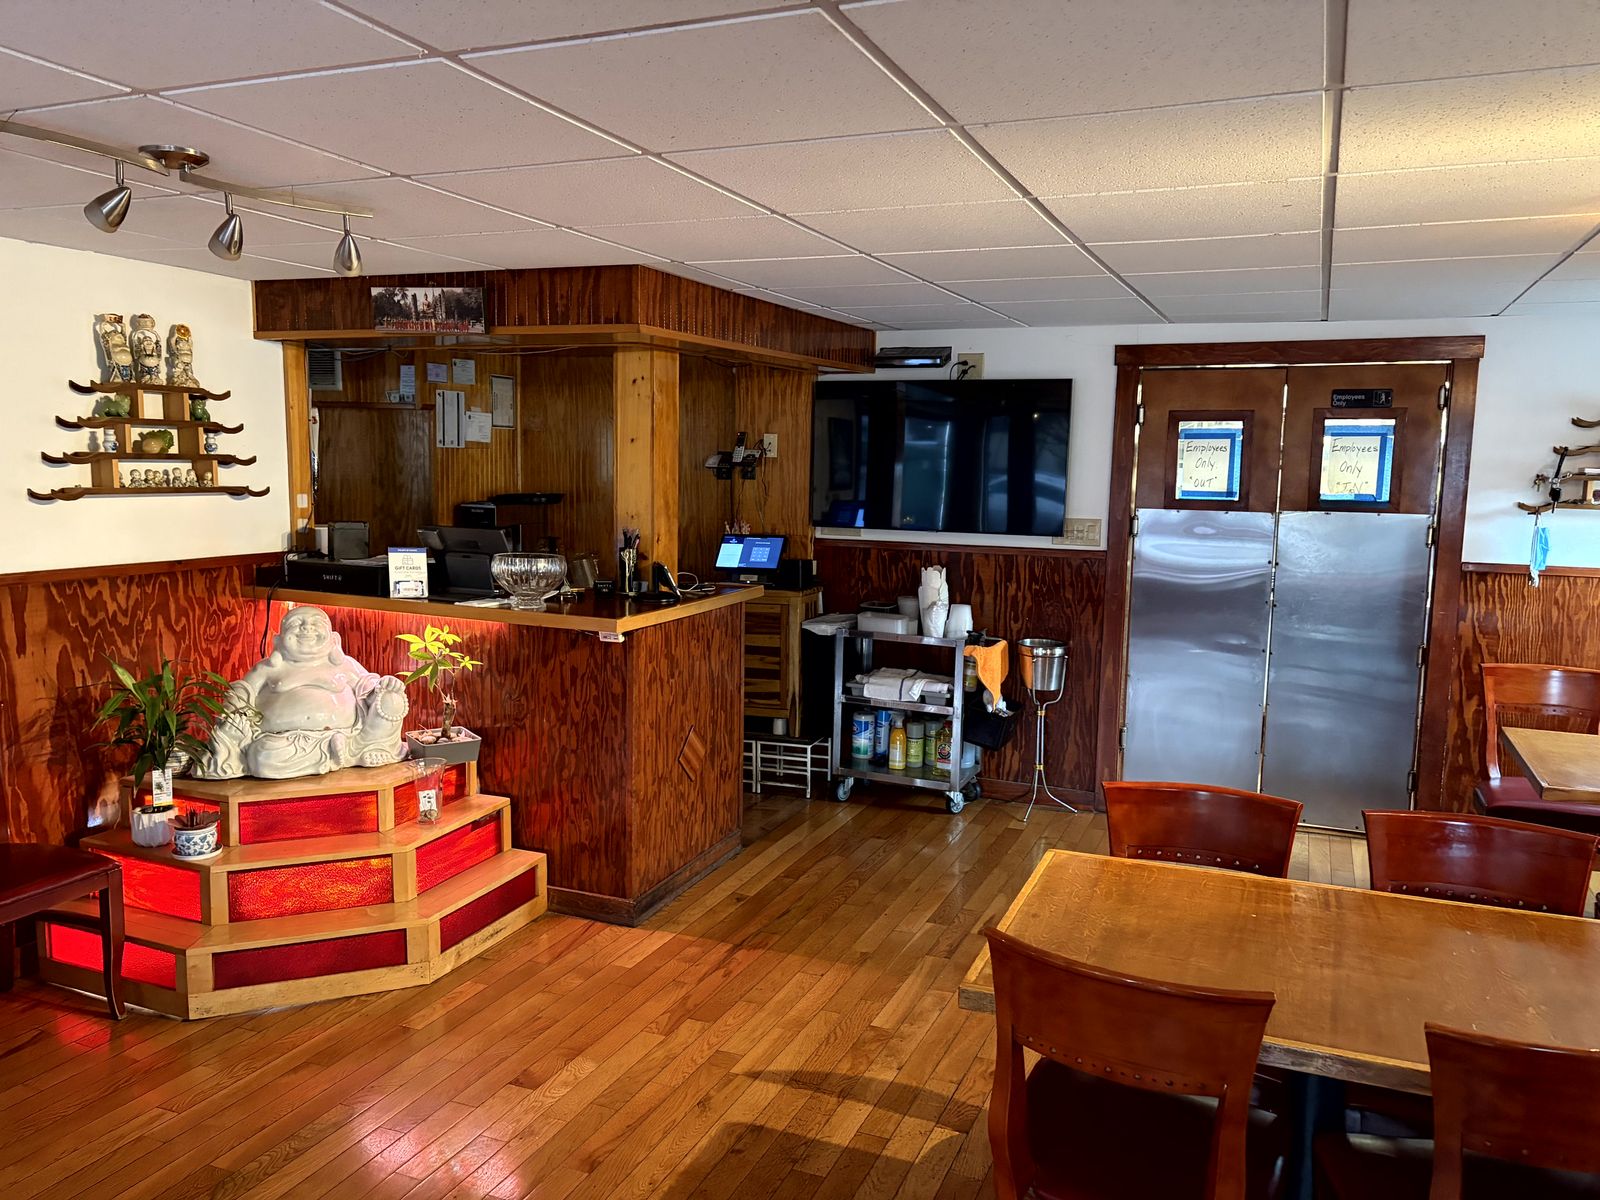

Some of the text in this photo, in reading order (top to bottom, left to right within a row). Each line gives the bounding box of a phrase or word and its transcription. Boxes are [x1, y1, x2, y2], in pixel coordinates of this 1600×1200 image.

[1332, 393, 1365, 401] Employees
[1186, 440, 1228, 455] Employees
[1332, 437, 1378, 457] Employees
[1194, 457, 1216, 471] Only
[1339, 460, 1363, 478] Only
